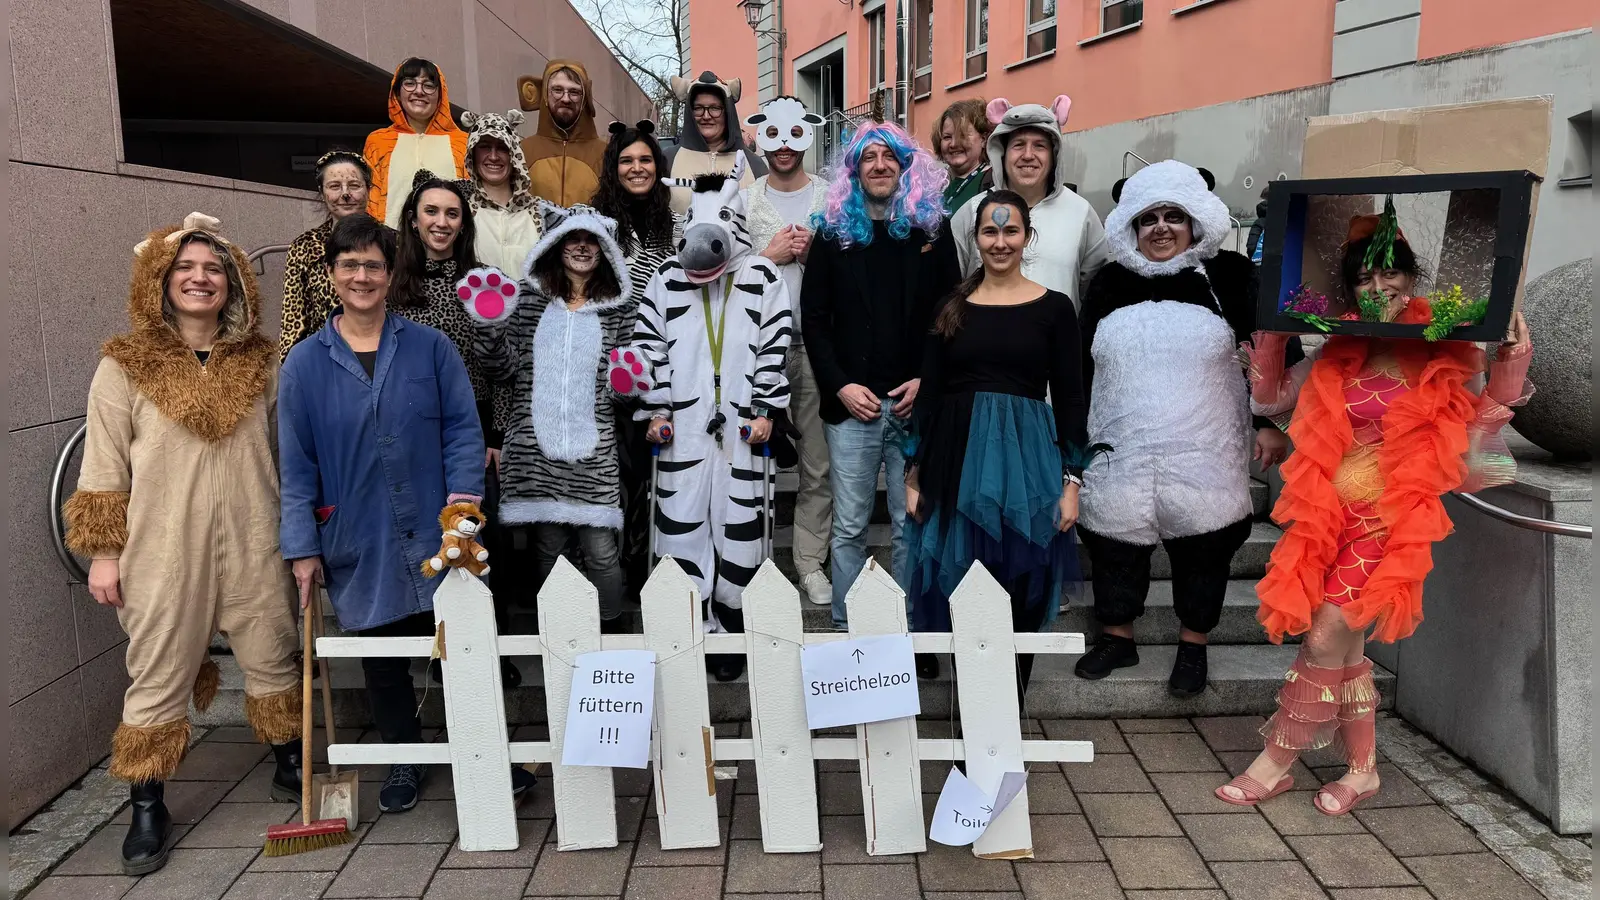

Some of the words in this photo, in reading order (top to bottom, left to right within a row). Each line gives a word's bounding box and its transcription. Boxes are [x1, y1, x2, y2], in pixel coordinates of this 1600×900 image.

[592, 669, 635, 685] Bitte
[810, 672, 911, 696] Streichelzoo
[578, 697, 643, 714] füttern
[599, 726, 619, 745] !!!
